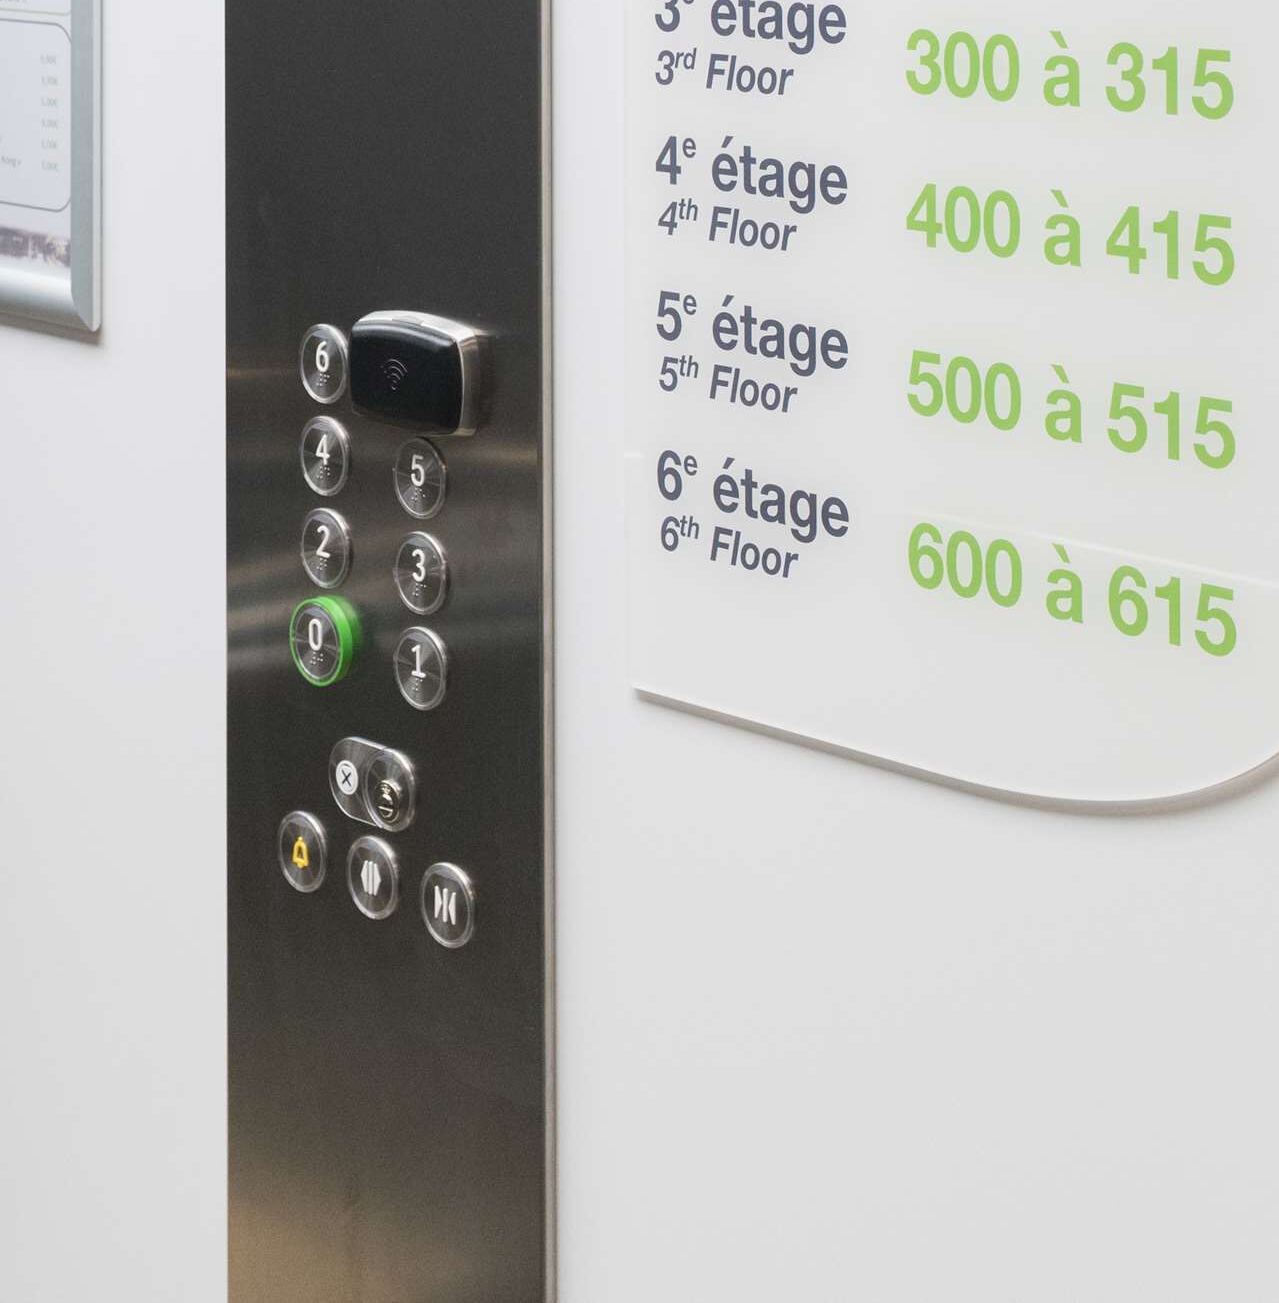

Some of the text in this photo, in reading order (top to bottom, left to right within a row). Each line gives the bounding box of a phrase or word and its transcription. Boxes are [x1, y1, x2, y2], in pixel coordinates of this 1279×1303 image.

[655, 47, 793, 95] 3rd Floor
[905, 28, 1233, 121] 300 à 315
[656, 136, 847, 214] 4e étage
[658, 198, 796, 251] 4th Floor
[905, 182, 1236, 287] 400 à 415
[316, 340, 329, 372] 6
[656, 290, 848, 377] 5e étage
[659, 355, 797, 413] 5th Floor
[907, 349, 1236, 470] 500 à 515
[316, 434, 330, 465] 4
[411, 455, 424, 486] 5
[657, 450, 849, 544] 6e étage
[316, 525, 330, 558] 2
[412, 549, 425, 581] 3
[661, 515, 799, 578] 6th Floor
[907, 522, 1237, 657] 600 à 615
[309, 618, 323, 650] 0
[412, 644, 426, 678] 1
